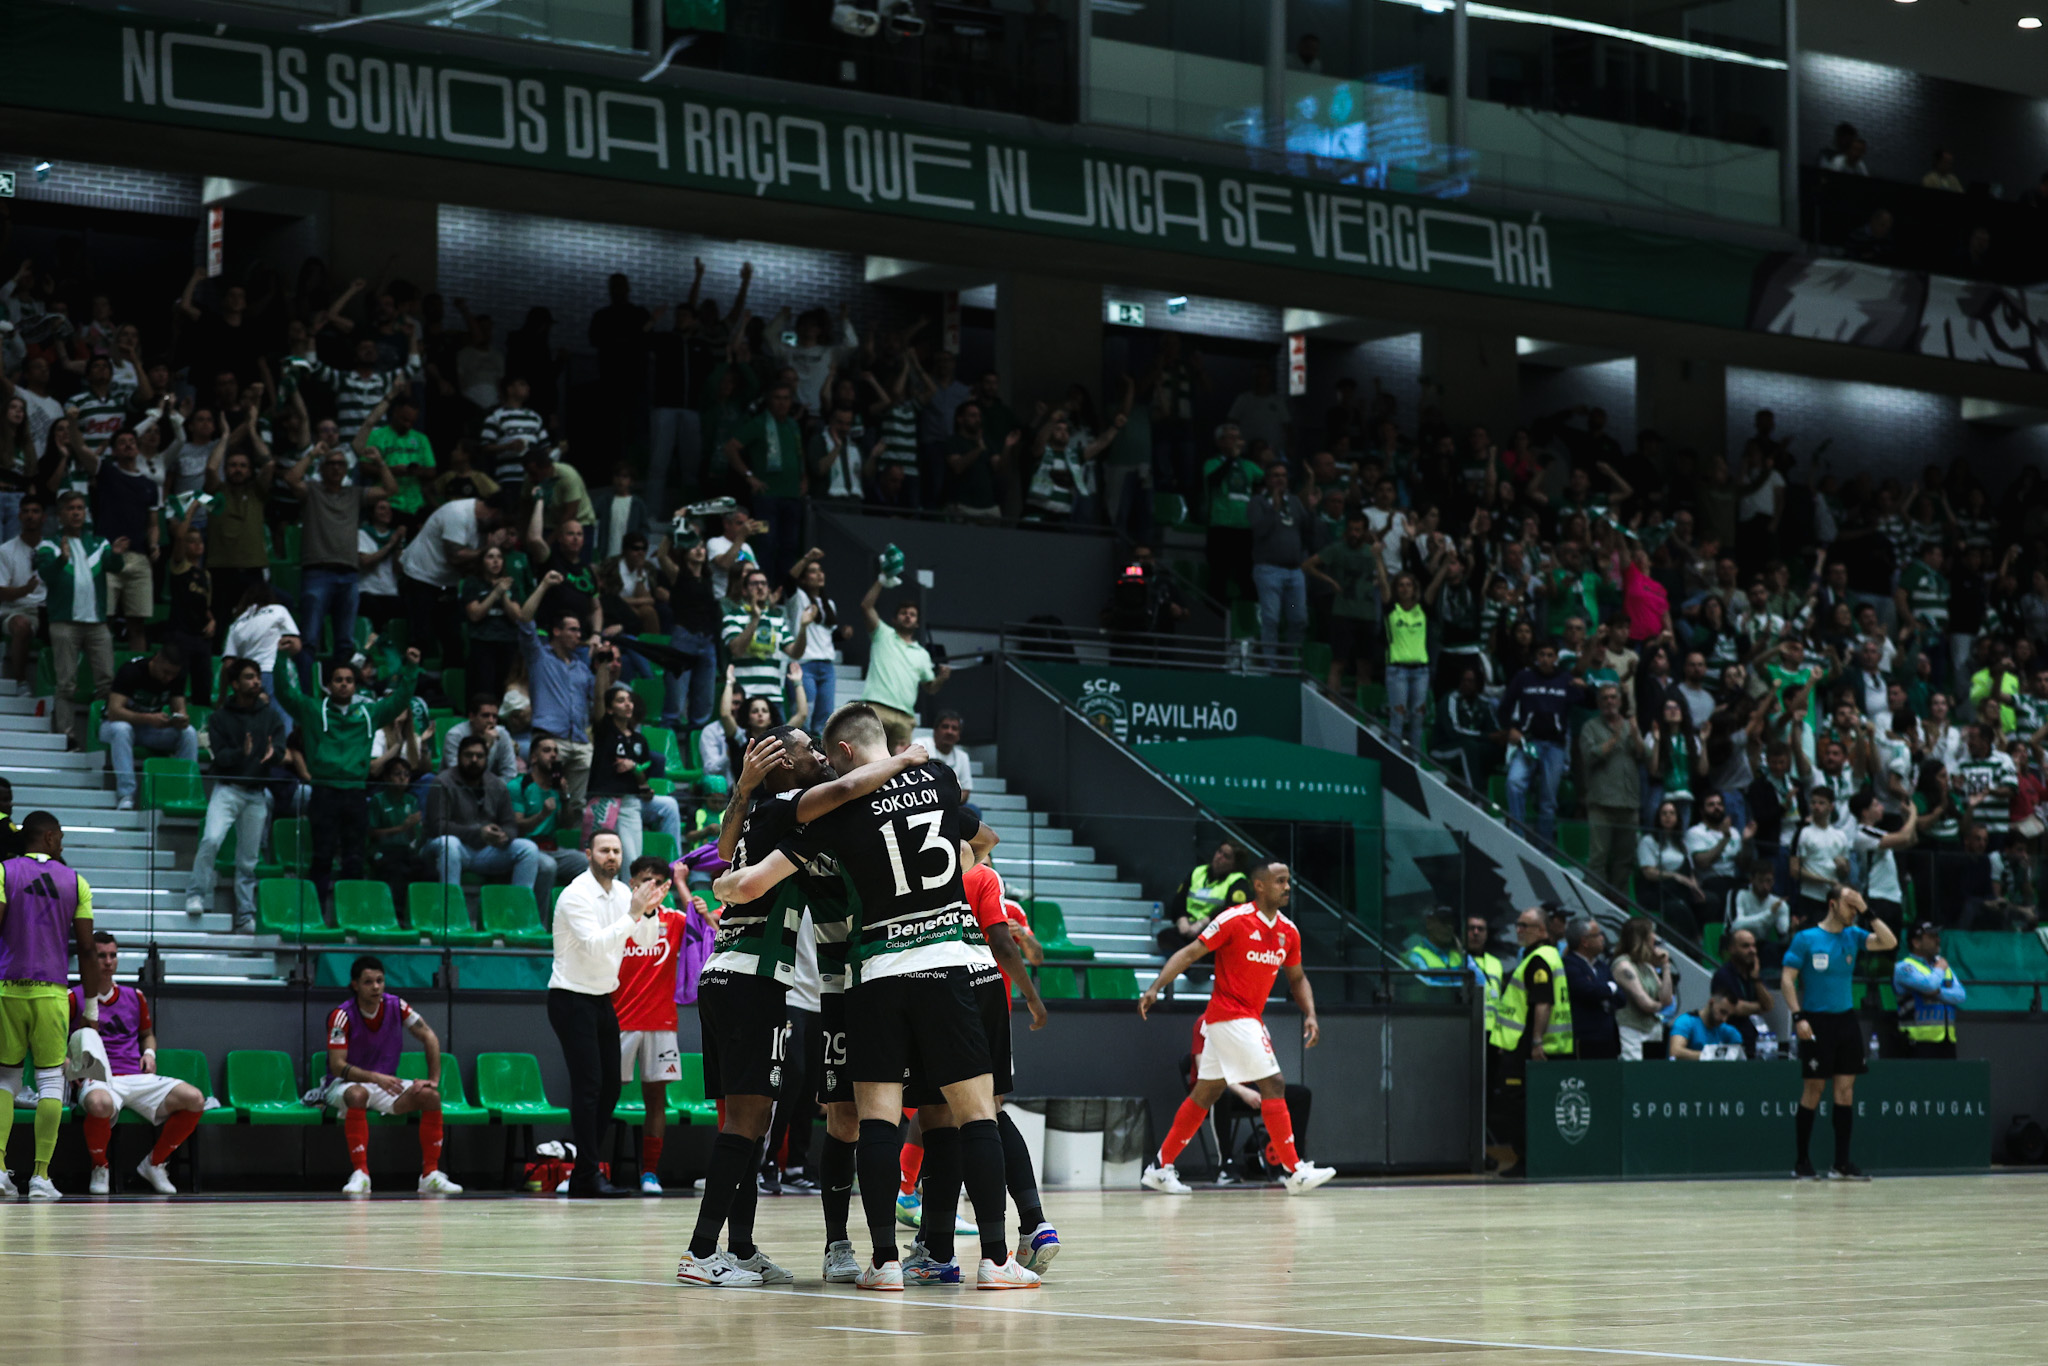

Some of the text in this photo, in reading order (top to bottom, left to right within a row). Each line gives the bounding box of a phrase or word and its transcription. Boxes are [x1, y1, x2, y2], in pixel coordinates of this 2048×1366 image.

[122, 23, 1552, 289] NÓS SOMOS DA RAÇA QUE NUNCA SE VERGARÁ
[1082, 678, 1121, 695] SCP
[1131, 701, 1238, 731] PAVILHÃO
[1224, 776, 1267, 789] CLUBE
[1275, 779, 1291, 790] DE
[1299, 781, 1368, 795] PORTUGAL
[871, 788, 939, 816] SOKOLOV
[878, 809, 957, 897] 13
[1560, 1077, 1586, 1091] SCP
[1632, 1101, 1745, 1118] SPORTING
[1760, 1101, 1827, 1117] CLUE
[1881, 1101, 1985, 1117] PORTUGAL
